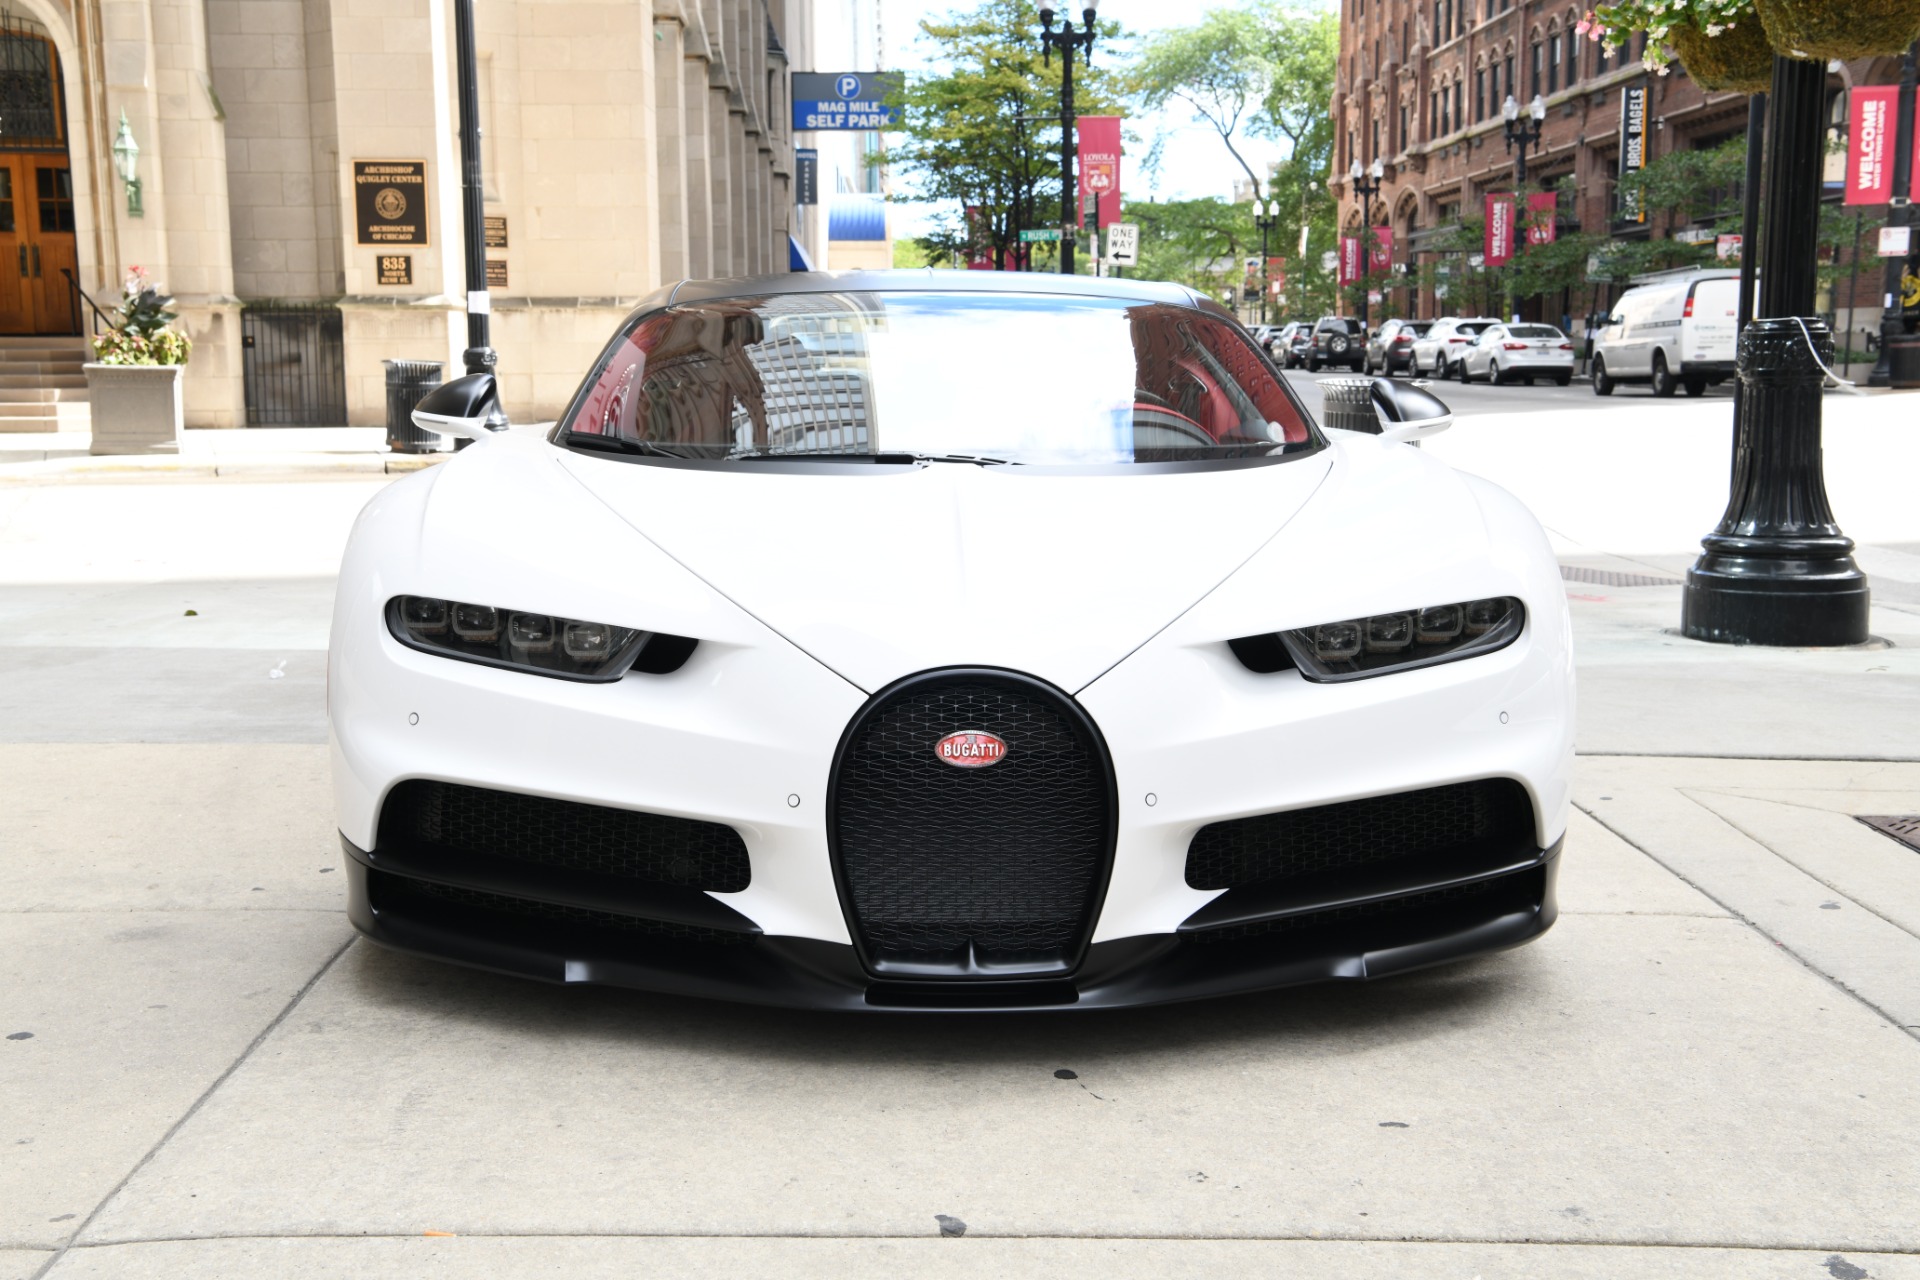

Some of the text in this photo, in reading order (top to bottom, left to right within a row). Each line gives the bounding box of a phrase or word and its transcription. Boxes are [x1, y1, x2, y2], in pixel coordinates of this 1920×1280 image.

[841, 77, 856, 96] P
[817, 101, 880, 113] MAG MILE
[1628, 89, 1644, 133] BAGELS
[806, 114, 890, 127] SELF PARK
[1626, 135, 1642, 167] BROS.
[1858, 100, 1878, 190] WELCOME
[1873, 100, 1886, 190] WATER TOWER CAMPUS
[1083, 153, 1116, 161] LOYOLA
[364, 166, 414, 174] ARCHBISHOP
[356, 175, 423, 184] QUIGLEY CENTER
[1028, 230, 1050, 241] RUSH
[1112, 228, 1133, 238] ONE
[1491, 202, 1503, 257] WELCOME
[1111, 240, 1133, 248] WAY
[382, 256, 406, 270] 835
[1345, 238, 1353, 280] WELCOME
[943, 743, 999, 757] BUGATTI
